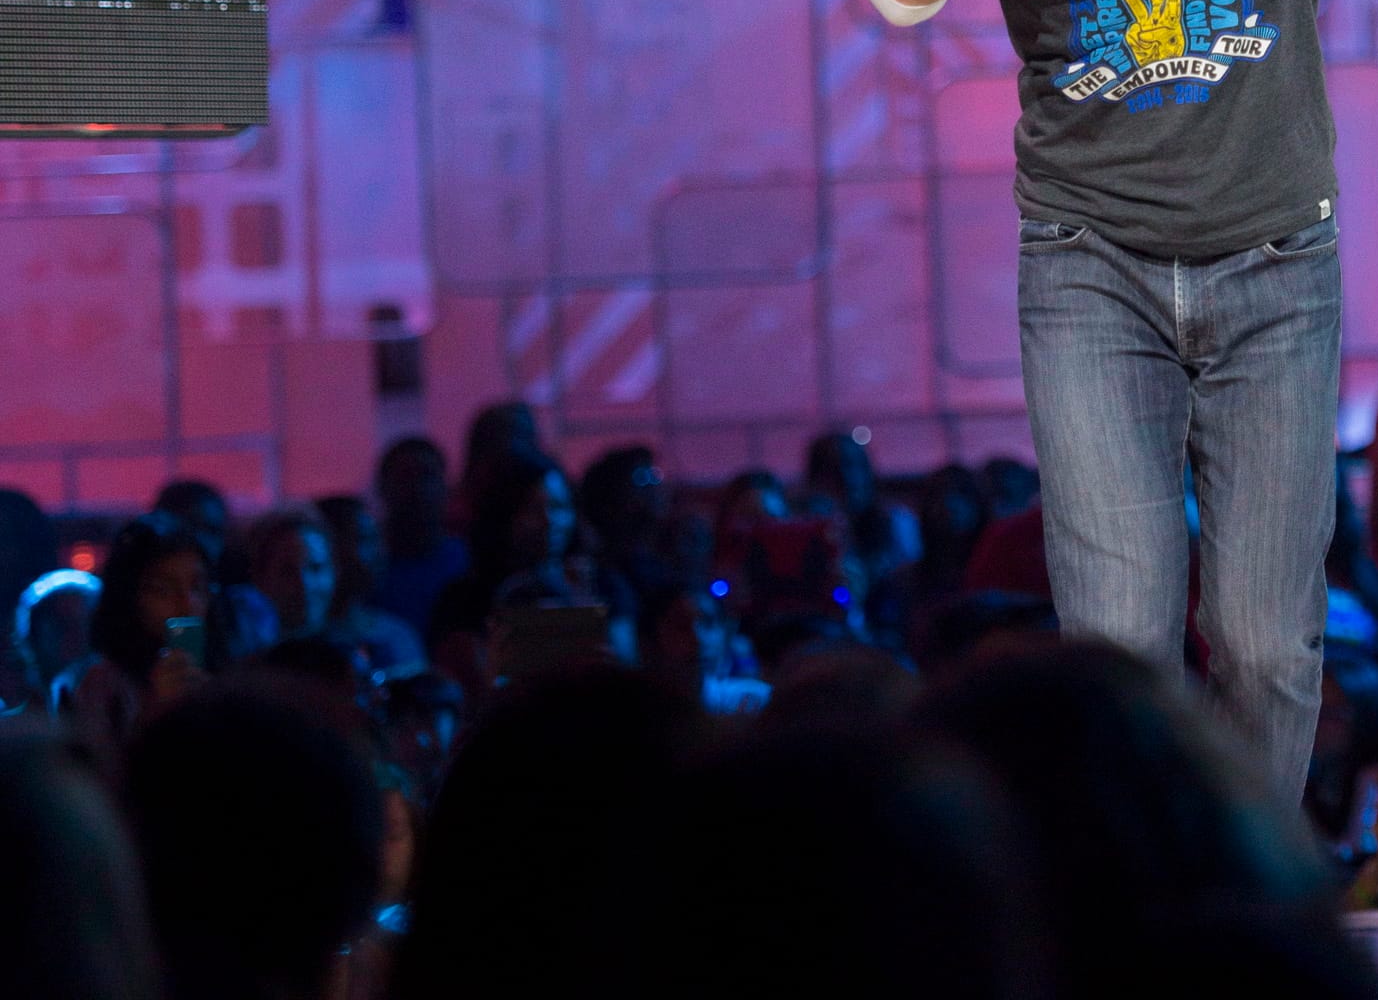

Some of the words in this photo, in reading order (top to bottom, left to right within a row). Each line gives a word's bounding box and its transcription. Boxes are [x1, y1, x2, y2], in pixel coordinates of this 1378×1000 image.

[1081, 16, 1106, 64] GET
[1186, 0, 1211, 51] FIND
[1069, 69, 1108, 98] THE
[1111, 59, 1218, 98] EMPOWER
[1220, 37, 1262, 56] TOUR
